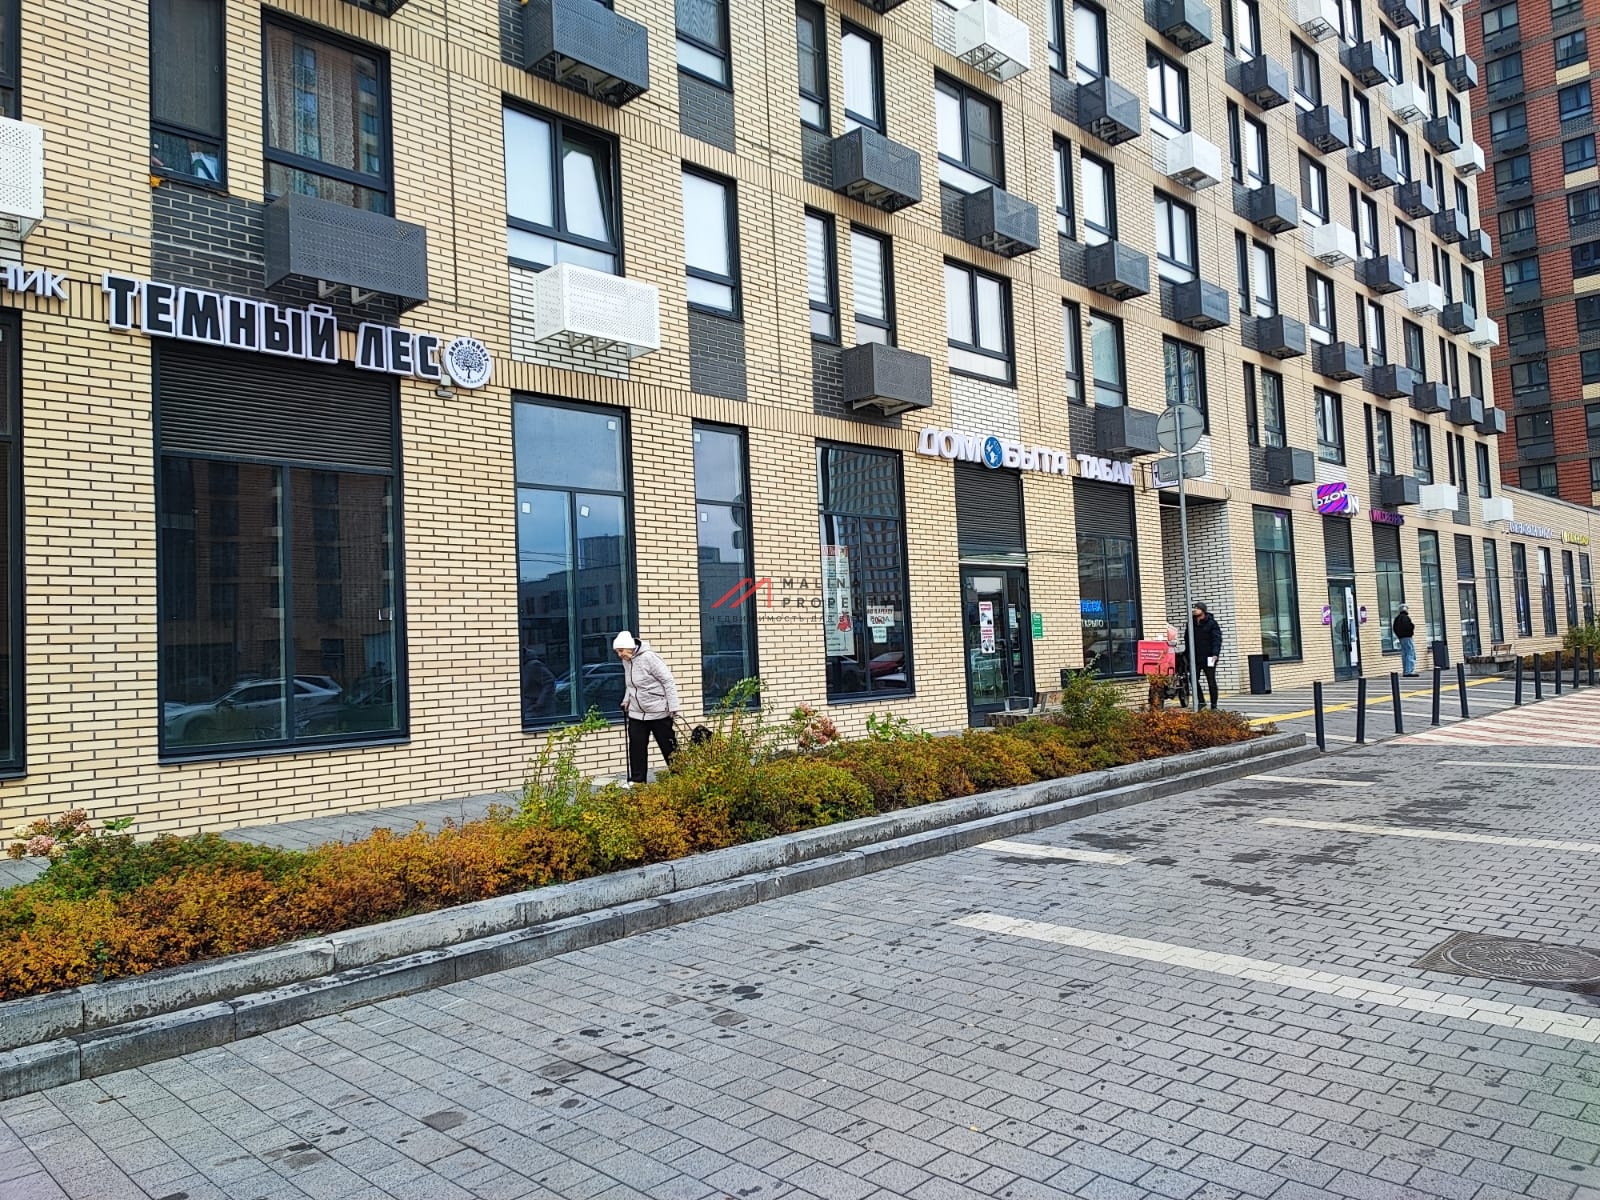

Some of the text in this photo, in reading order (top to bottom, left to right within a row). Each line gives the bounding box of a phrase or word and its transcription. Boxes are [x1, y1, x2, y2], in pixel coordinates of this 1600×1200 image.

[101, 272, 442, 382] ТЕМНЫЙ ЛЕС
[916, 428, 1068, 476] ДОМ БЫТА
[1076, 453, 1135, 485] ТАБАК
[1081, 619, 1104, 628] ТКРЫТО
